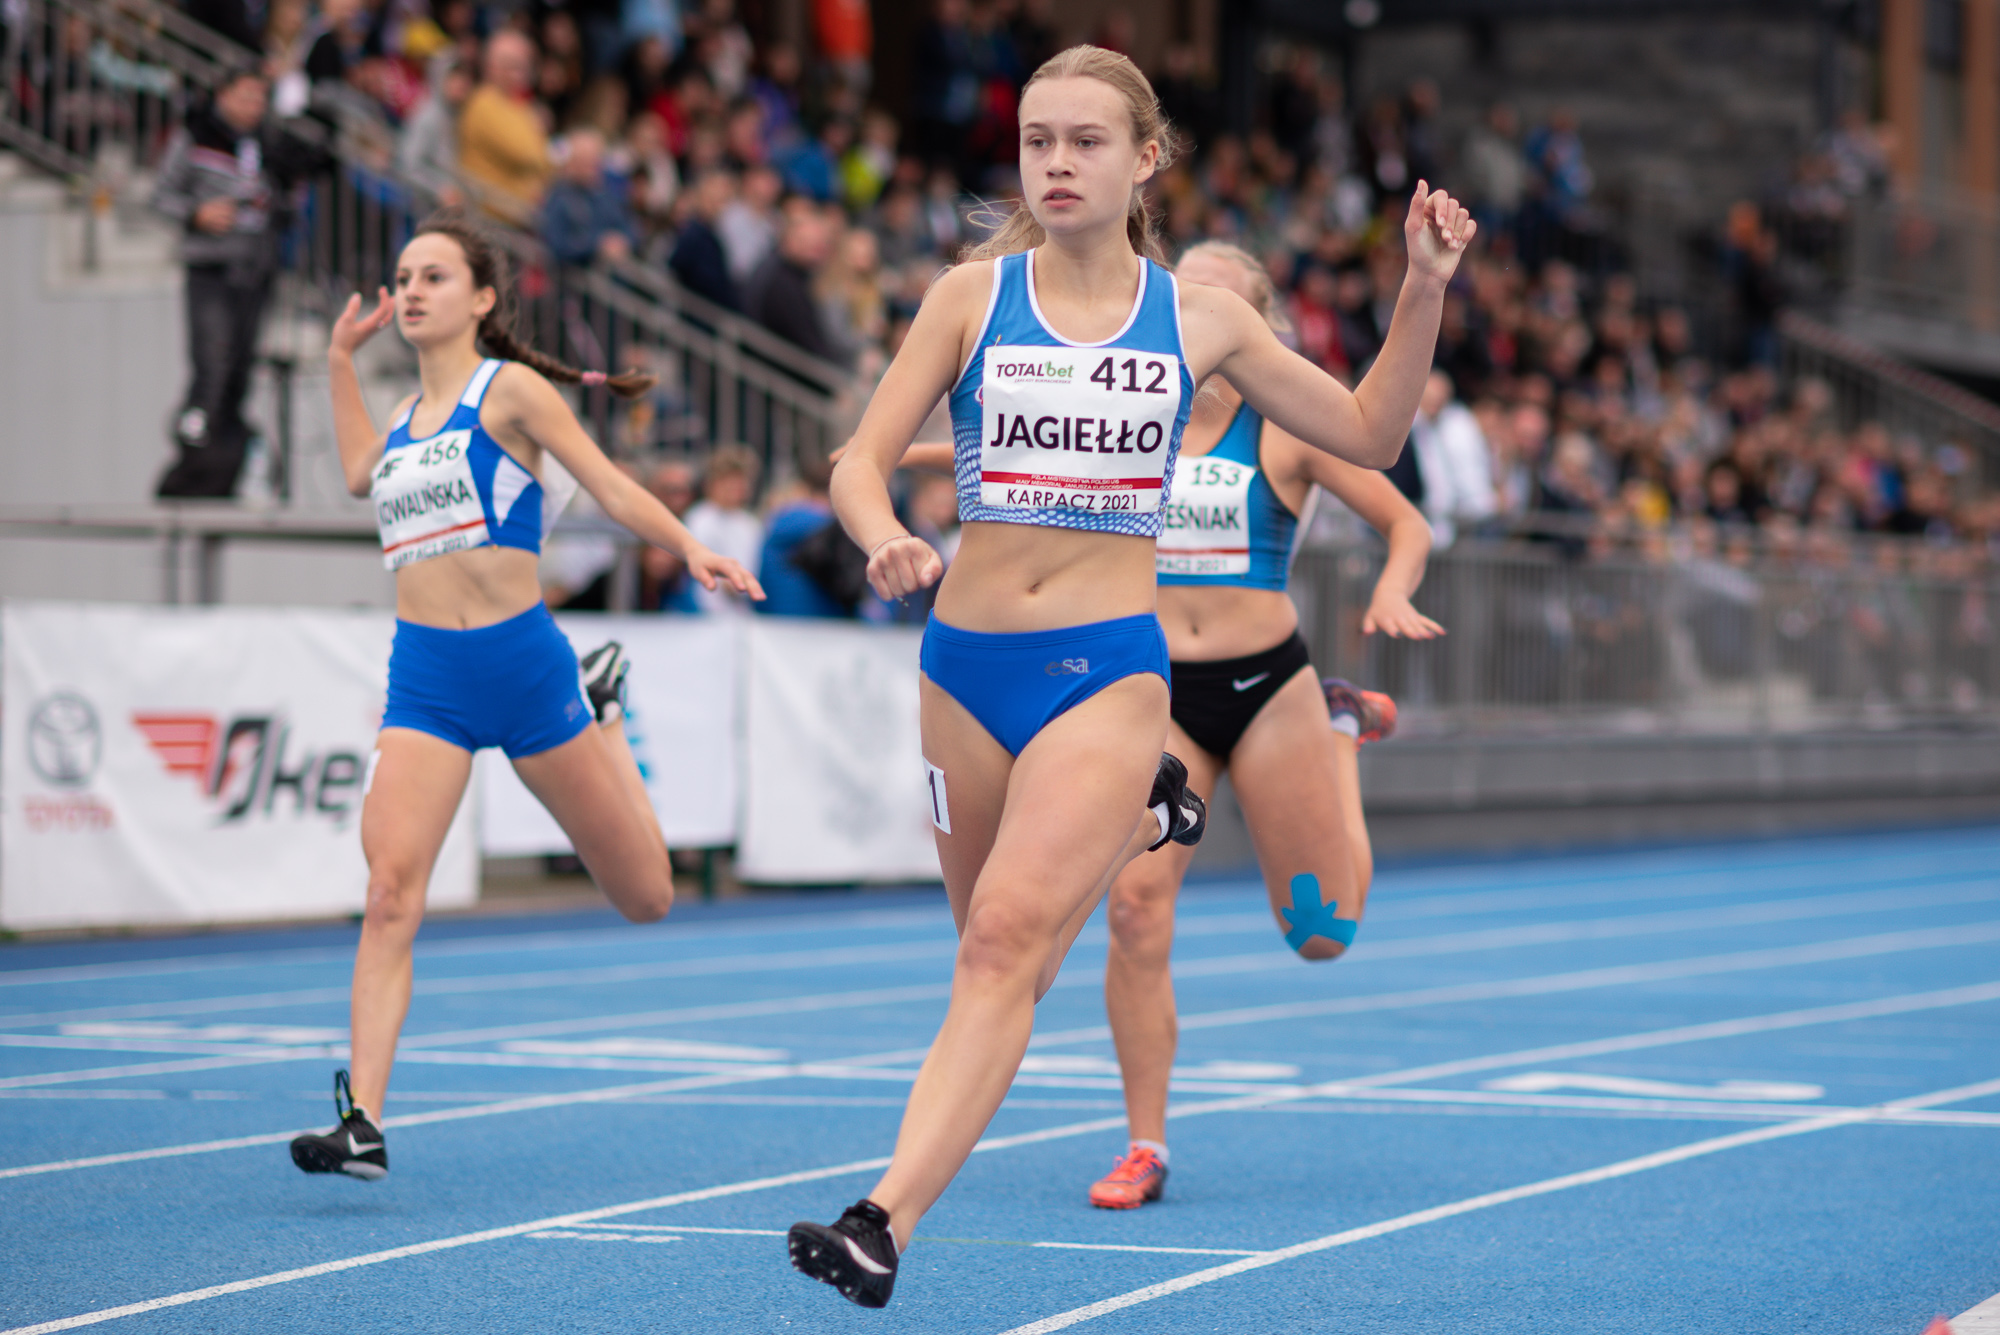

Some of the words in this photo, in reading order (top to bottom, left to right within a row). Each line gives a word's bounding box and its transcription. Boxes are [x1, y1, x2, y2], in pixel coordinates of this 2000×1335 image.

[997, 361, 1074, 378] TOTALbet
[1090, 357, 1168, 394] 412
[990, 413, 1163, 454] JAGIEŁŁO
[419, 438, 460, 466] 456
[1191, 463, 1242, 486] 153
[1007, 489, 1095, 510] KARPACZ
[1101, 494, 1137, 511] 2021
[1164, 498, 1240, 530] EŚNIAK
[441, 535, 469, 553] 2021
[1156, 559, 1191, 571] PACZ
[1196, 559, 1227, 571] 2021
[929, 769, 941, 824] 1
